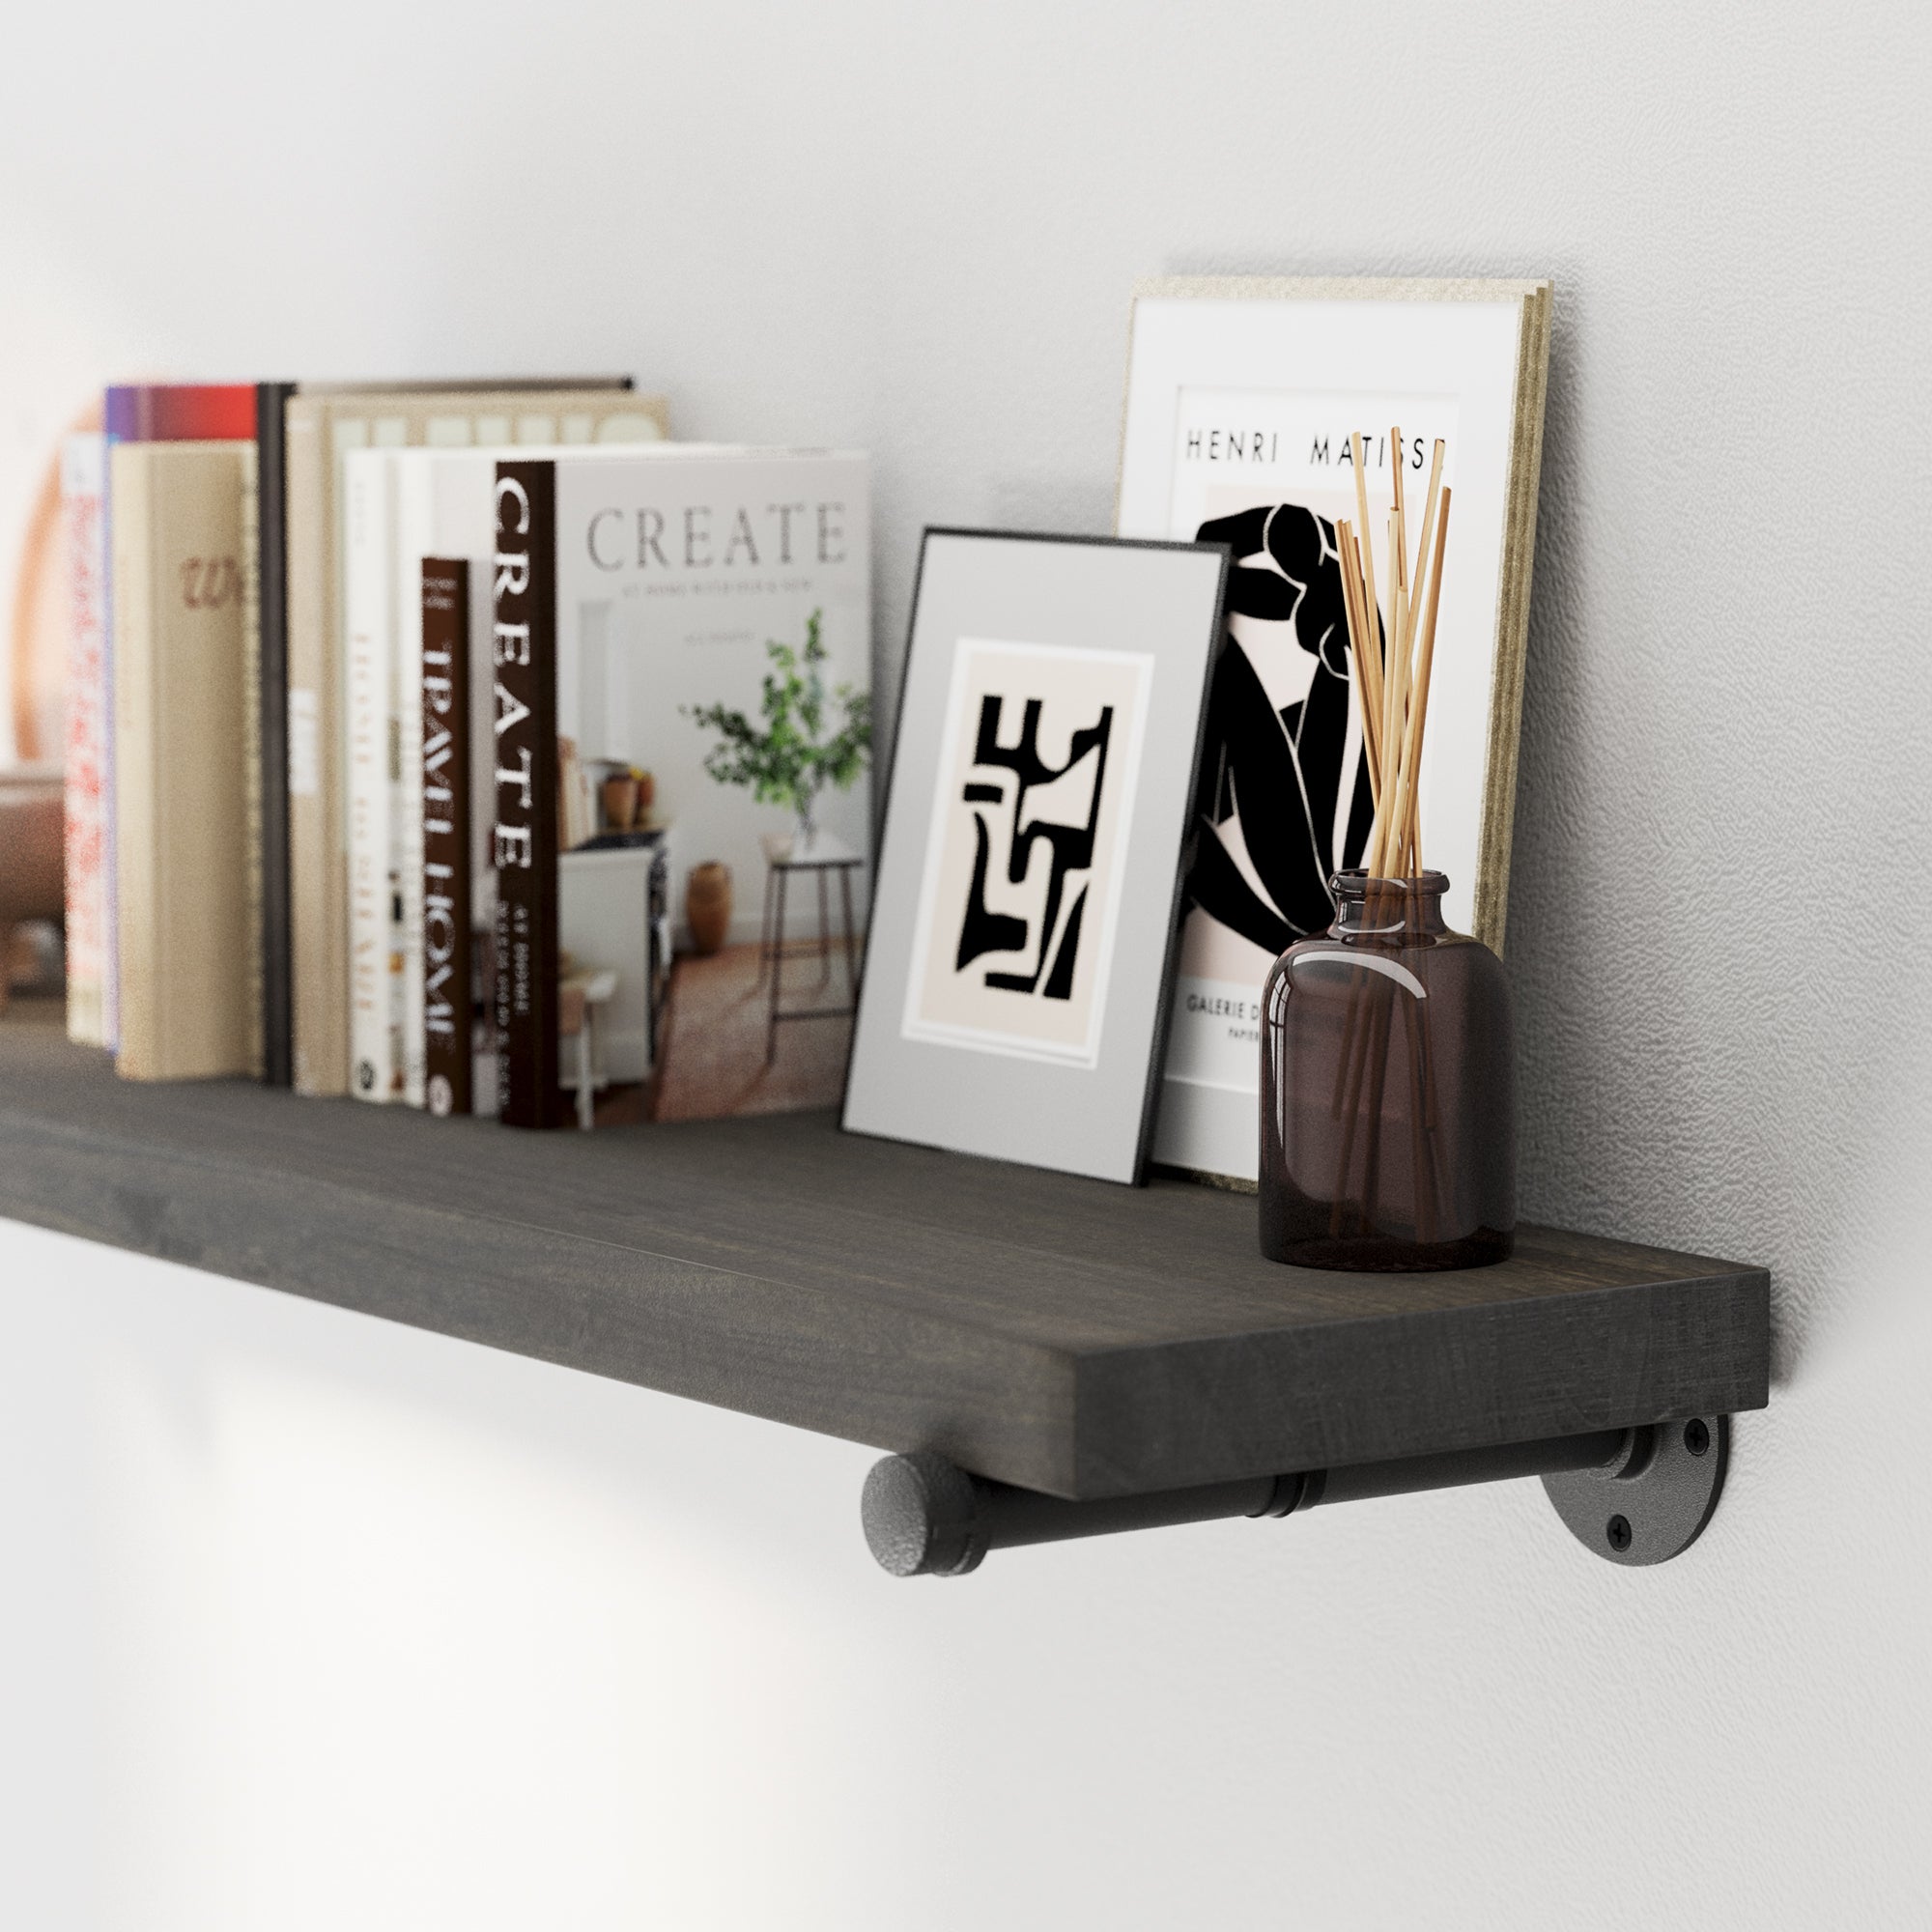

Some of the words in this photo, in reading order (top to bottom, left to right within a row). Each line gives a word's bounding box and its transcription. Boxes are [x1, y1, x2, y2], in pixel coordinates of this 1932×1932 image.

[1186, 431, 1278, 463] HENRI
[1310, 435, 1445, 469] MATIS
[585, 501, 847, 572] CREATE
[494, 476, 530, 867] CREATE
[423, 638, 454, 846] TRAVEL
[424, 862, 456, 1056] HOME
[1186, 993, 1244, 1019] GALERIE
